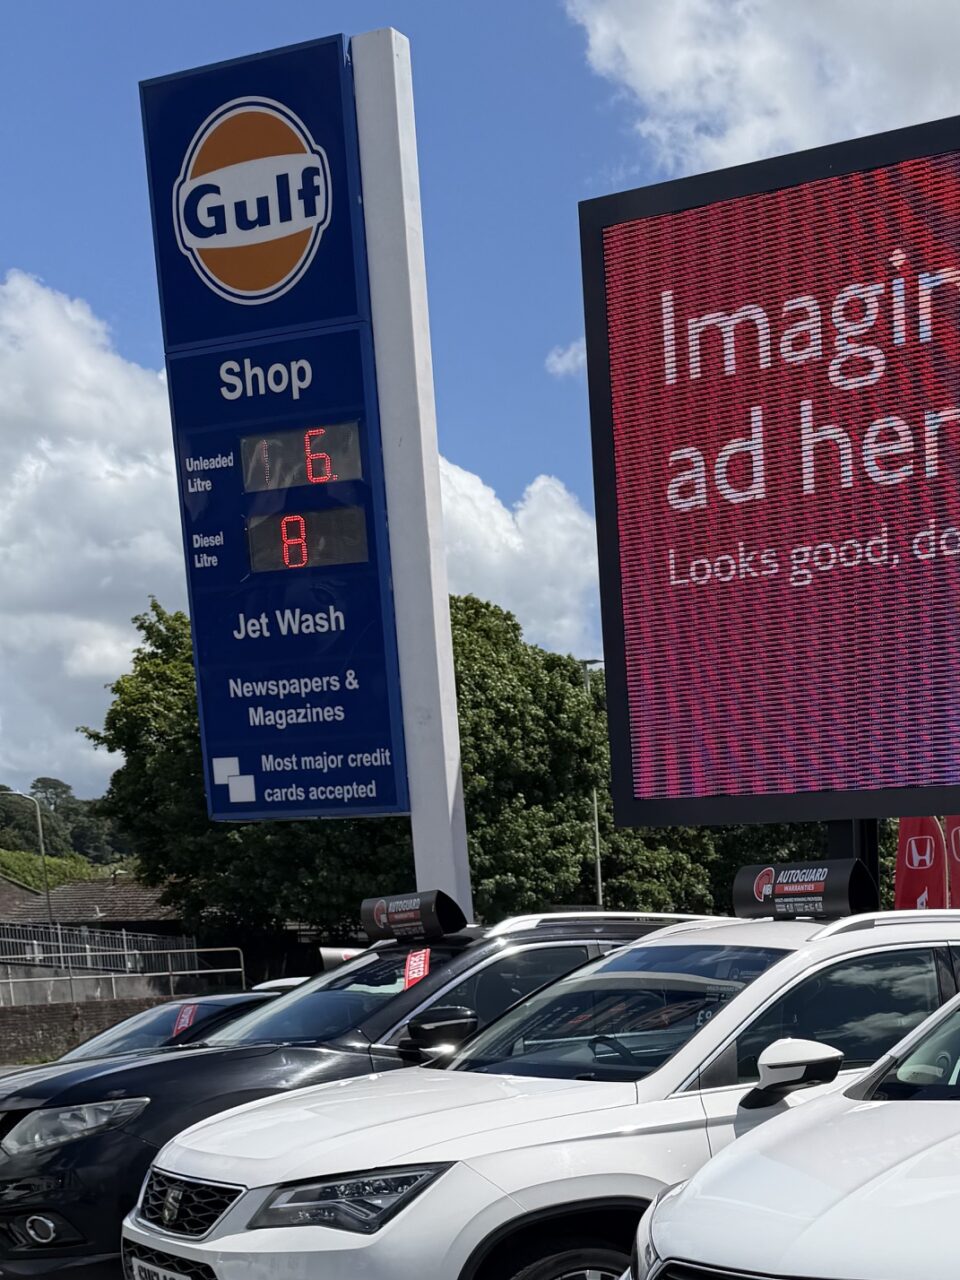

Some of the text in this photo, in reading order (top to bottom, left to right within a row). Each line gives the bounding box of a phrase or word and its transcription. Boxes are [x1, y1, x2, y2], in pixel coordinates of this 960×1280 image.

[183, 166, 321, 239] Gulf
[219, 358, 313, 401] Shop
[185, 452, 234, 472] Unleaded
[666, 405, 766, 511] ad
[187, 478, 212, 493] Litre
[192, 531, 224, 548] Diesel
[280, 515, 309, 568] 8
[194, 554, 218, 568] Litre
[667, 541, 779, 586] Looks
[789, 521, 900, 587] good,
[233, 605, 346, 639] Jet Wash
[228, 669, 360, 699] Newspapers &
[248, 703, 345, 729] Magazines
[261, 748, 392, 773] Most major credit
[264, 780, 376, 802] cards accepted
[776, 868, 829, 883] AUTOGUARD
